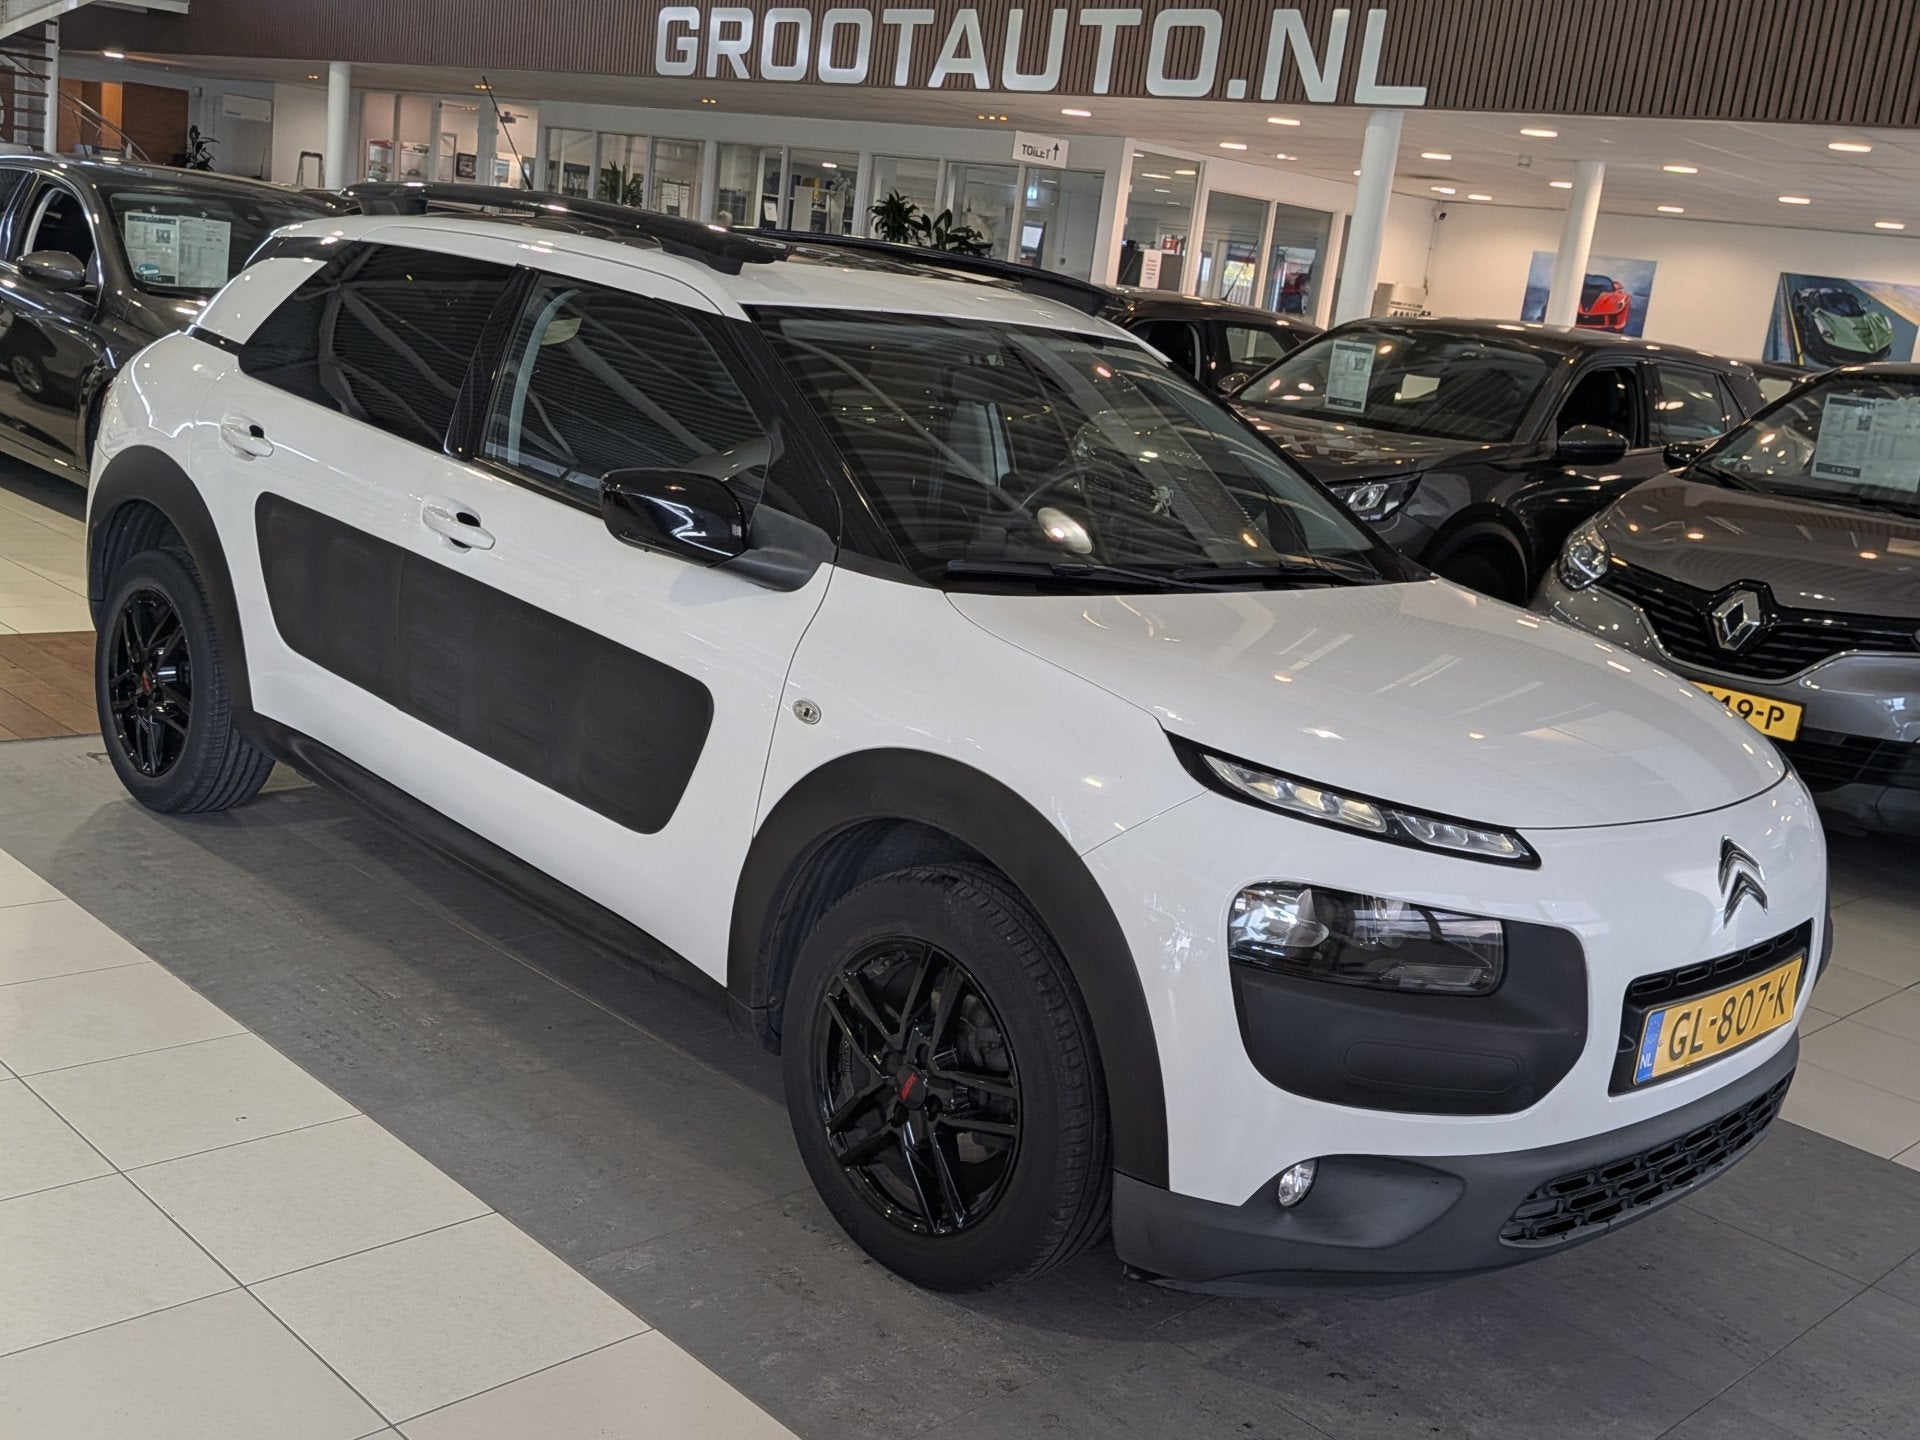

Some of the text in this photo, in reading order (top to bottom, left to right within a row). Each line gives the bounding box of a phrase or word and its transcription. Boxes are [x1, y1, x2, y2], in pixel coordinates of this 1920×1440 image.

[655, 6, 1428, 106] GROOTAUTO.NL
[1639, 1052, 1652, 1070] NL
[1669, 970, 1792, 1062] GL-807-K
